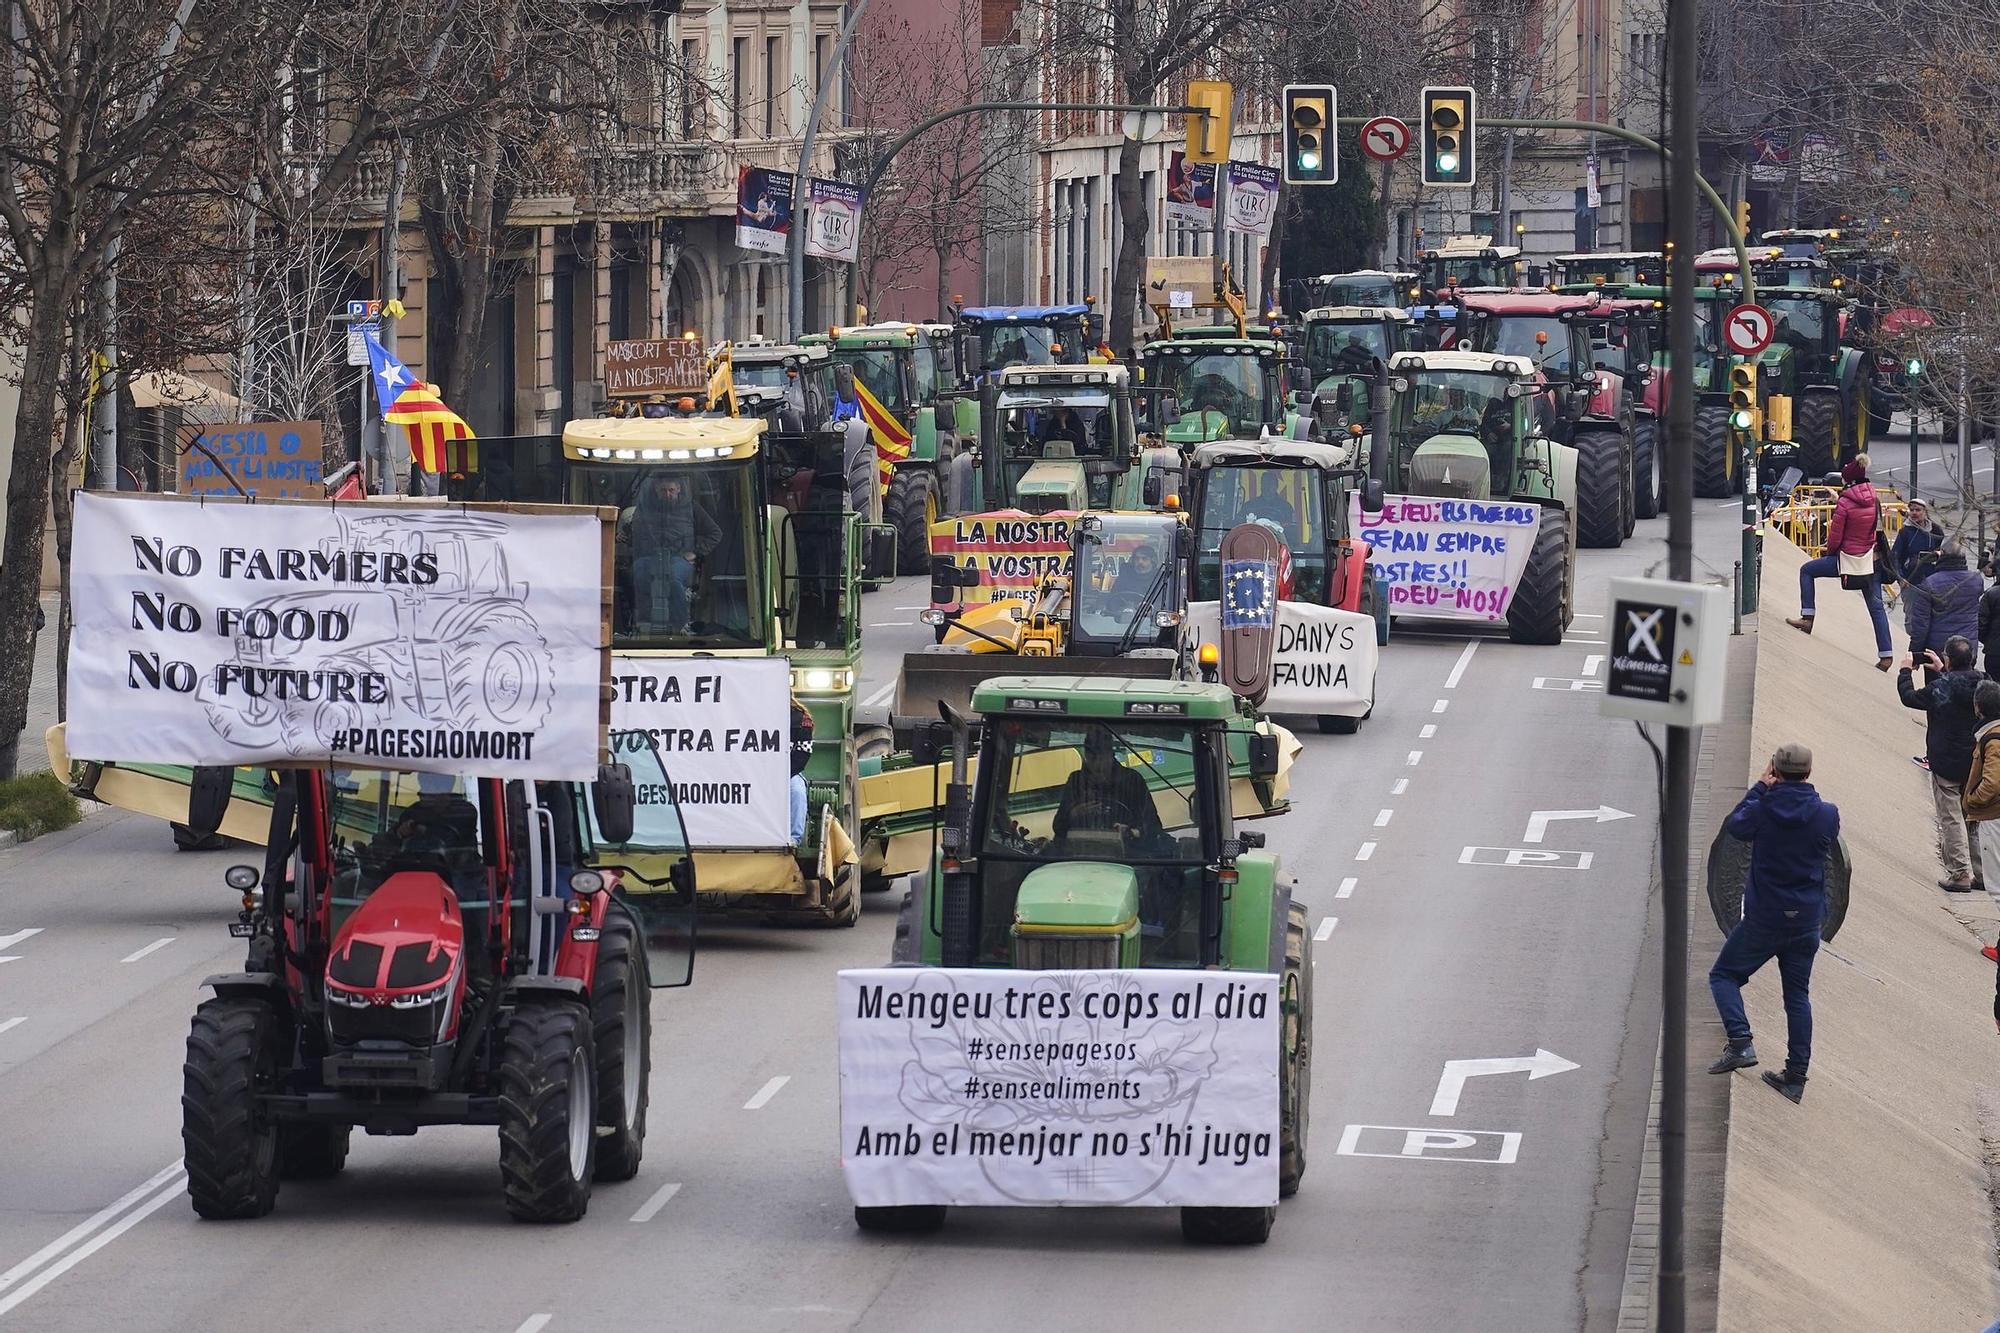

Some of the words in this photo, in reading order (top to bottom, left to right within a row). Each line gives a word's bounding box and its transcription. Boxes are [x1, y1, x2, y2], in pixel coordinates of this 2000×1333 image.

[1261, 169, 1276, 178] Circ
[815, 182, 822, 190] El
[823, 184, 843, 194] millor
[844, 187, 859, 197] Circ
[1240, 193, 1266, 213] CIRC
[823, 215, 849, 237] CIRC
[353, 303, 363, 315] P
[609, 369, 622, 389] LA
[956, 522, 986, 543] LA
[994, 521, 1074, 543] NOSTR
[1374, 559, 1467, 588] OSTRES!!
[1277, 622, 1354, 654] DANYS
[1273, 663, 1348, 689] FAUNA
[694, 675, 721, 703] FI
[331, 729, 535, 761] #PAGESIAOMORT
[725, 729, 780, 753] FAM
[857, 985, 992, 1028] Mengeu
[1005, 988, 1071, 1019] tres
[1083, 989, 1160, 1028] cops
[1171, 983, 1203, 1019] al
[1213, 984, 1268, 1019] dia
[968, 1038, 1137, 1066] #sensepagesos
[964, 1077, 1141, 1100] #sensealiments
[856, 1126, 921, 1156] Amb
[932, 1124, 959, 1156] el
[969, 1130, 1083, 1165] menjar
[1091, 1133, 1129, 1156] no
[1139, 1125, 1193, 1157] s'hi
[1198, 1129, 1271, 1166] juga
[1401, 1131, 1476, 1155] P
